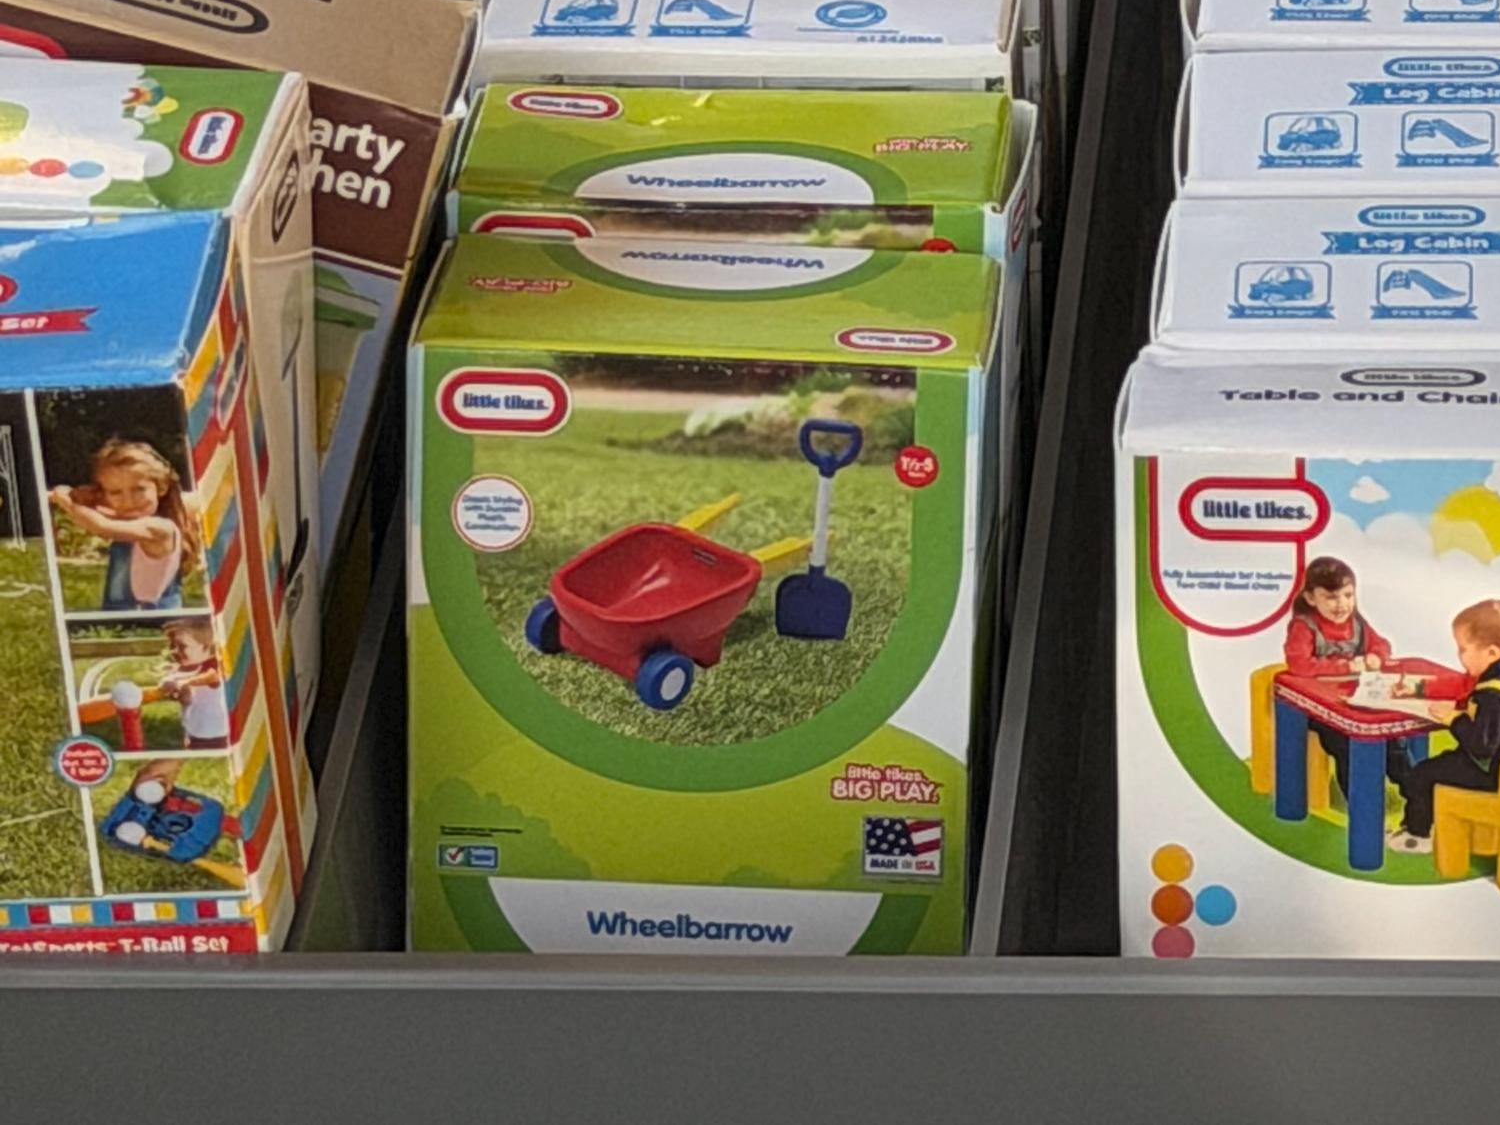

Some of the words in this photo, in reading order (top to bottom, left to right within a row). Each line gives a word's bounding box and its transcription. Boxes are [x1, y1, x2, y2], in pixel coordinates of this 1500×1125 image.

[1383, 86, 1428, 103] Log
[626, 173, 827, 189] Wheelbarrow
[1373, 211, 1420, 222] little
[1357, 236, 1406, 253] Log
[1415, 236, 1490, 250] Cabin
[621, 249, 826, 270] Wheelbarrow
[462, 392, 502, 409] little
[503, 394, 547, 410] tikes
[1219, 388, 1321, 402] Table
[1333, 389, 1405, 404] and
[1201, 499, 1251, 520] little
[1255, 501, 1311, 521] tikes
[848, 764, 882, 780] little
[832, 778, 874, 799] BIG
[880, 781, 935, 802] PLAY
[587, 910, 794, 944] Wheelbarrow
[118, 935, 187, 953] T-Ball
[192, 935, 230, 952] Set
